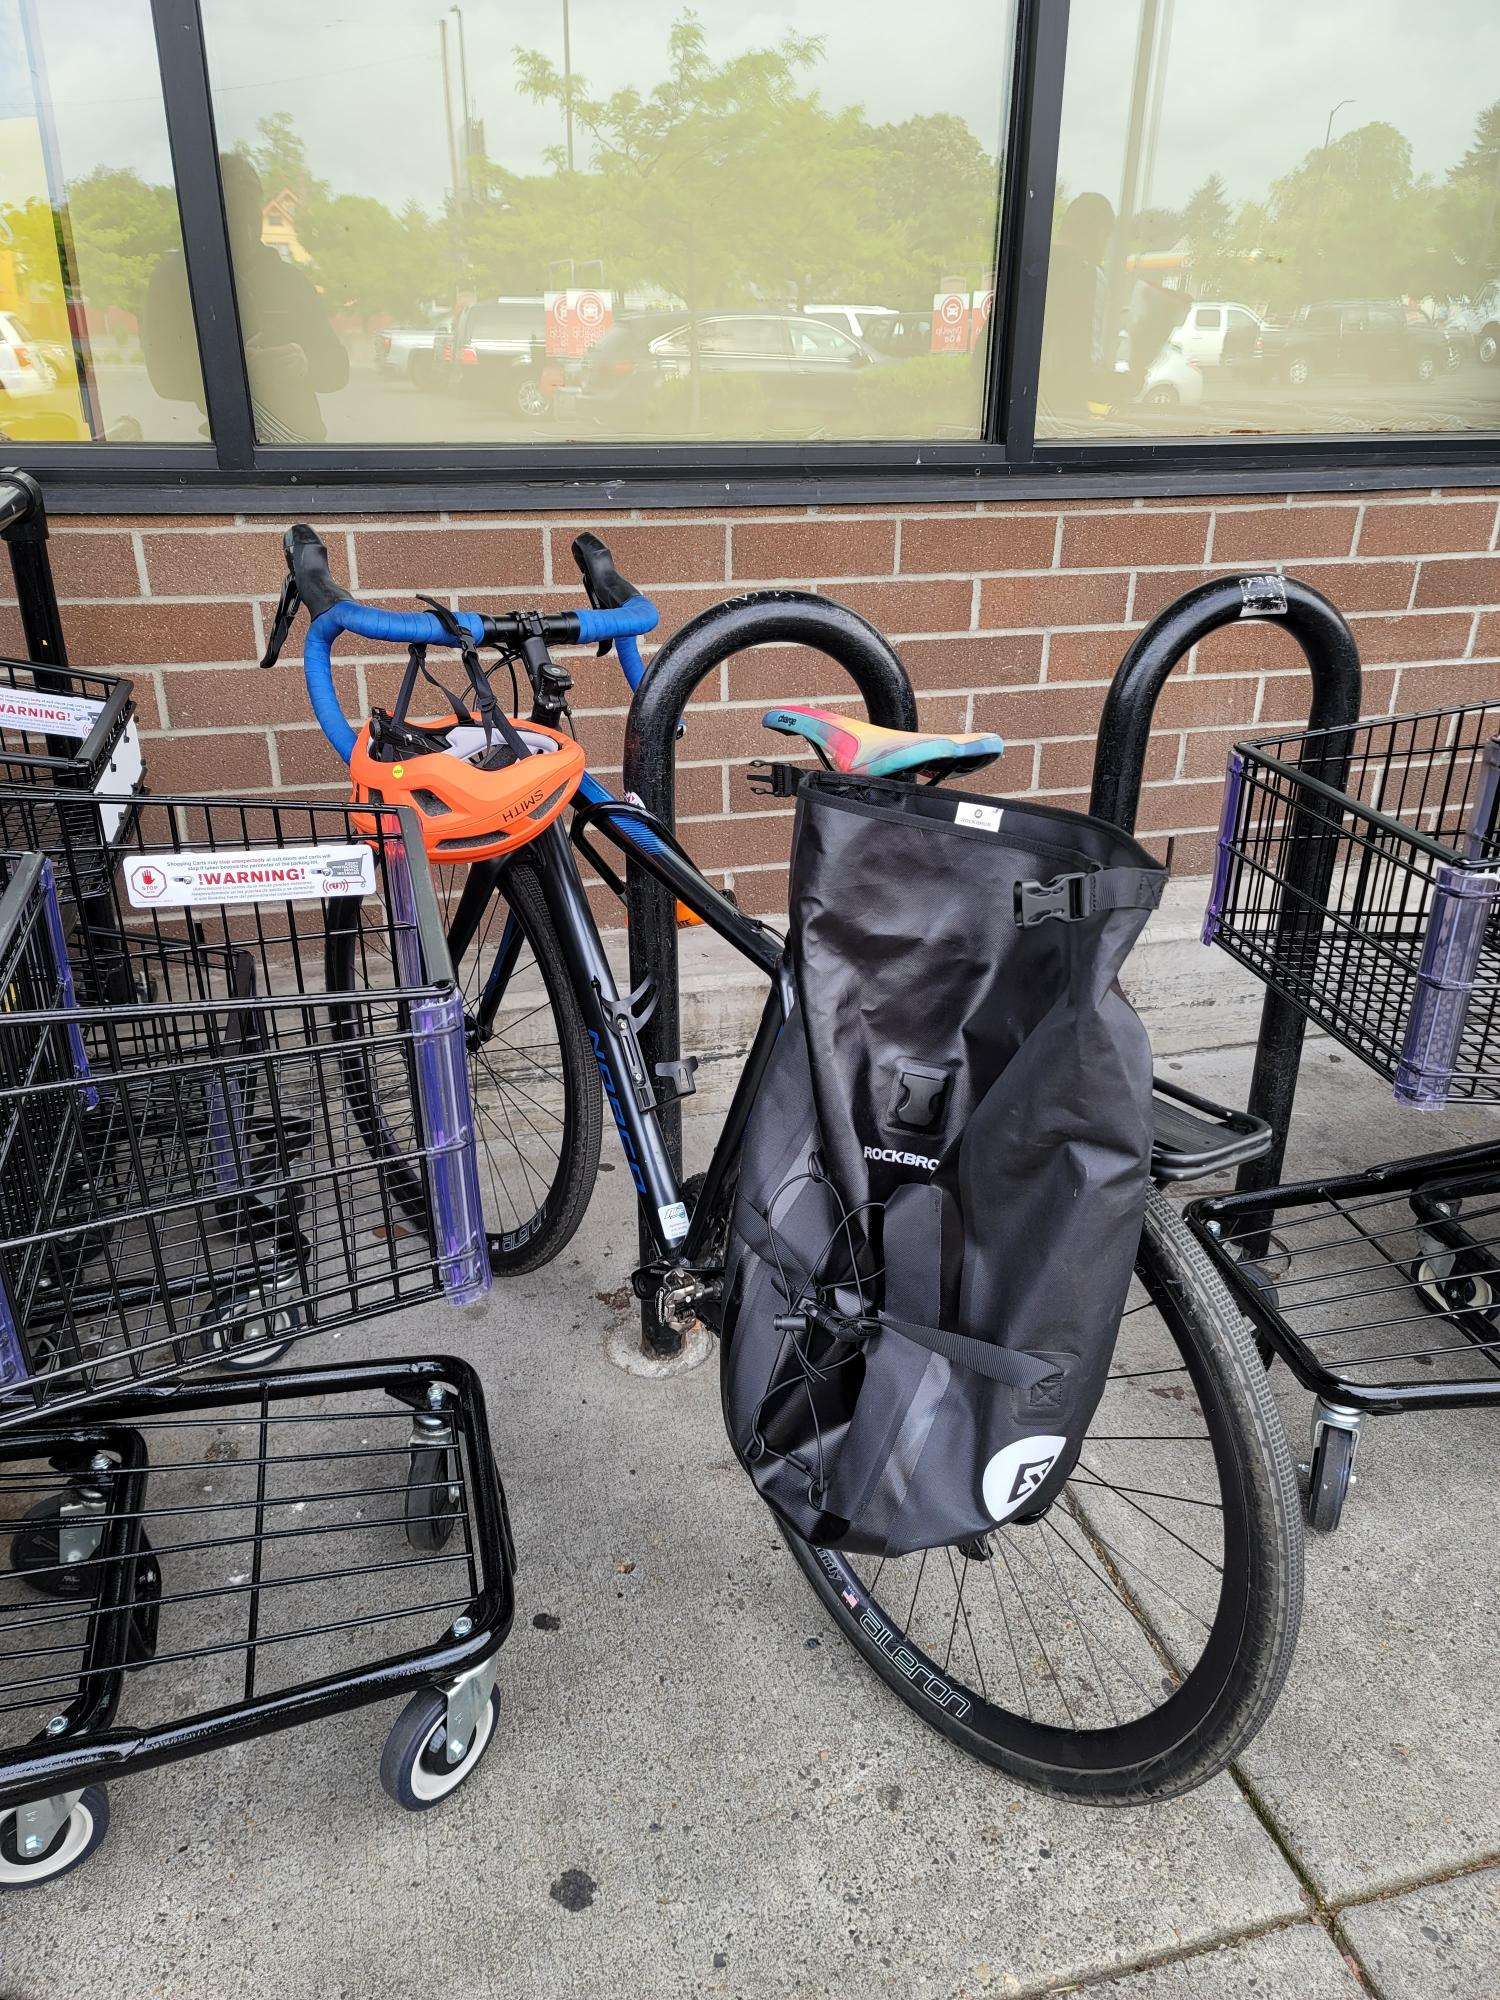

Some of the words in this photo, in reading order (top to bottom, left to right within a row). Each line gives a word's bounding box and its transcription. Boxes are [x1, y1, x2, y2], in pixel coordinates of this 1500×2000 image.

[777, 714, 797, 727] charge
[502, 789, 545, 822] SMITH
[587, 1028, 647, 1194] NORCO
[863, 1146, 940, 1171] ROCKBRO
